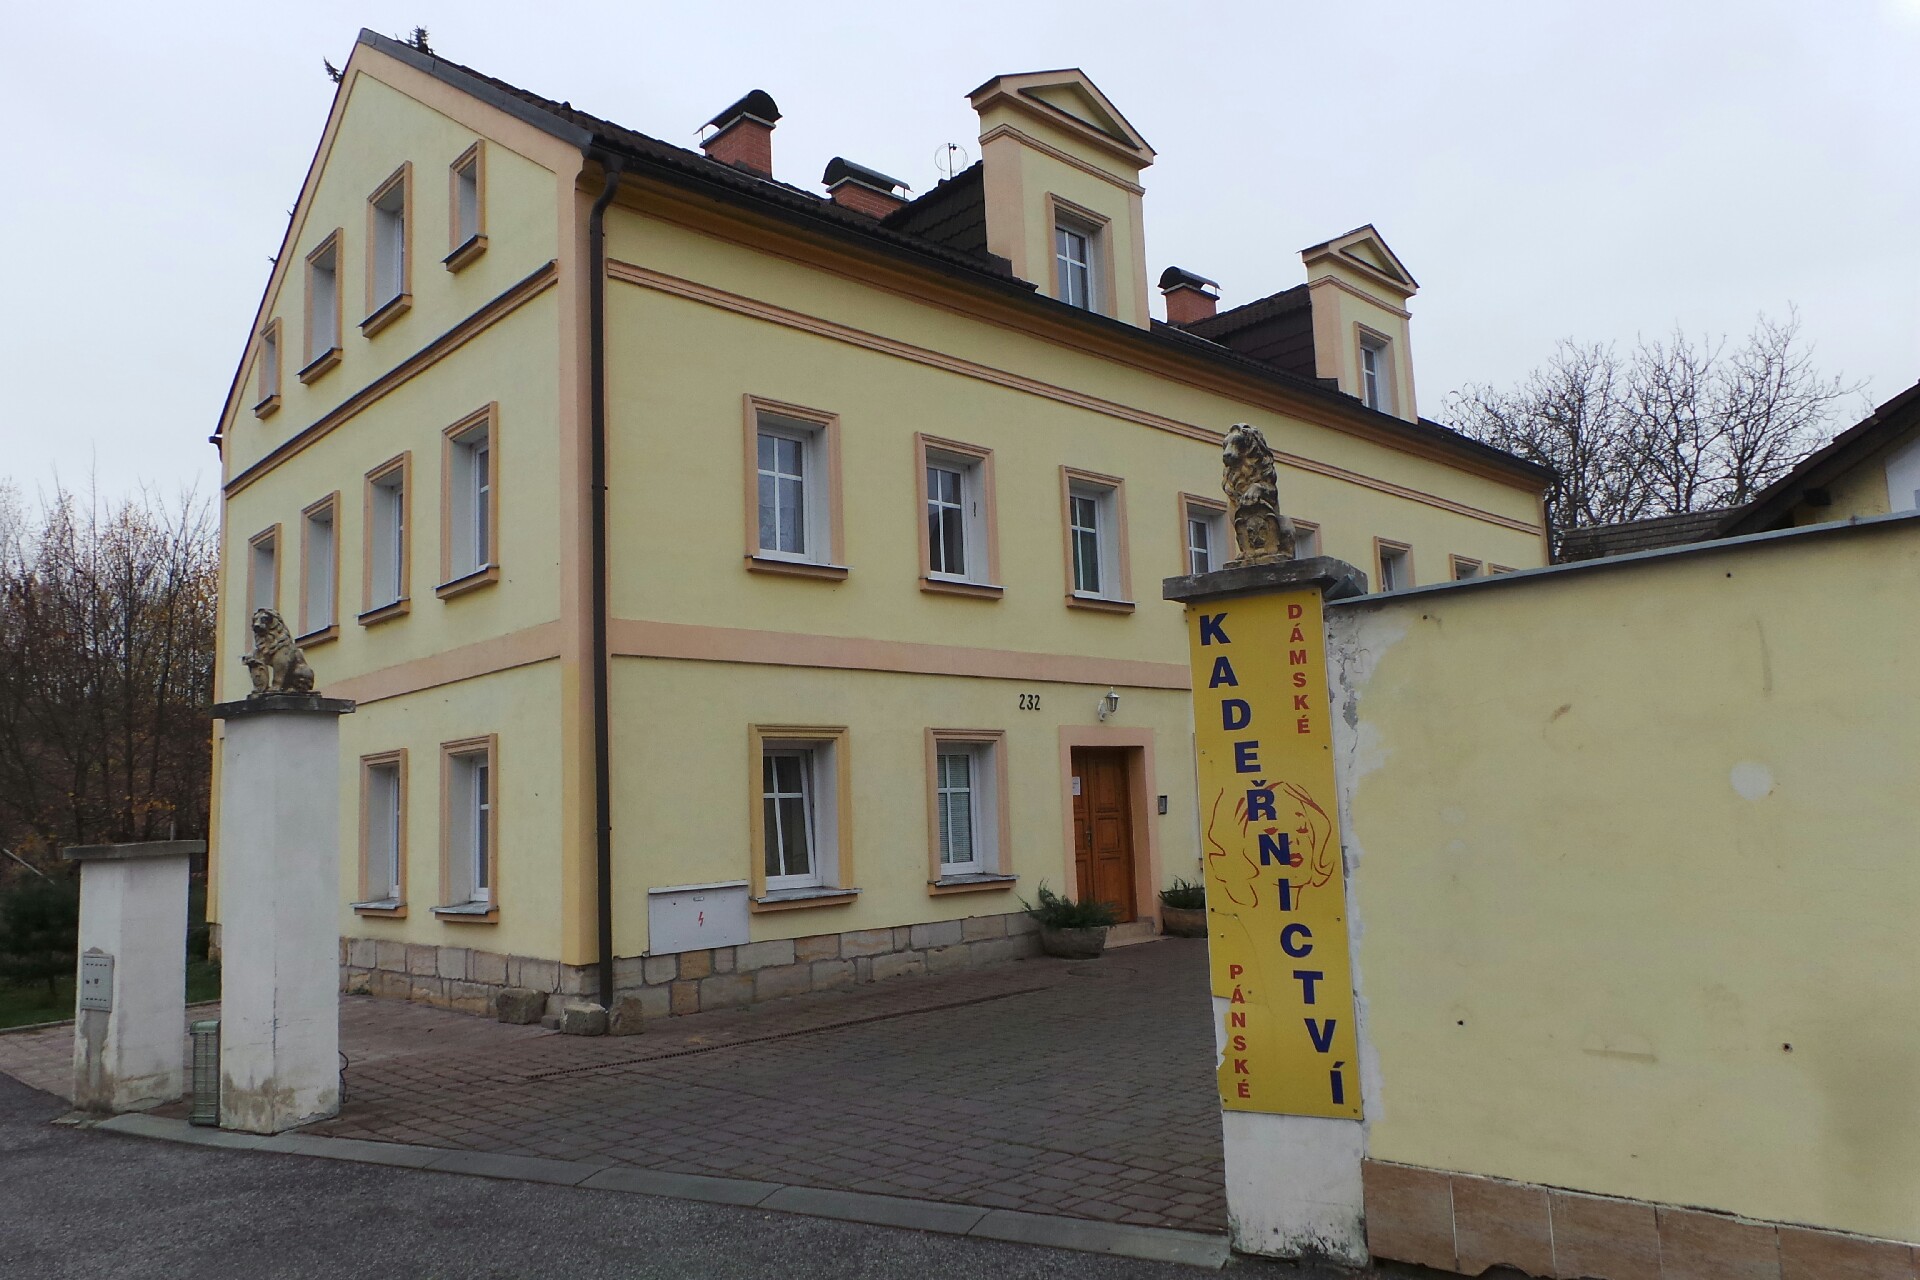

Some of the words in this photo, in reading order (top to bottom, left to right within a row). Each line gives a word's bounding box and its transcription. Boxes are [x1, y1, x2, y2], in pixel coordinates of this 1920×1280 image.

[1019, 693, 1041, 711] 232
[1287, 604, 1311, 734] DÁMSKÉ
[1199, 612, 1346, 1105] KADEŘNICTVÍ
[1229, 964, 1251, 1099] PÁNSKÉ
